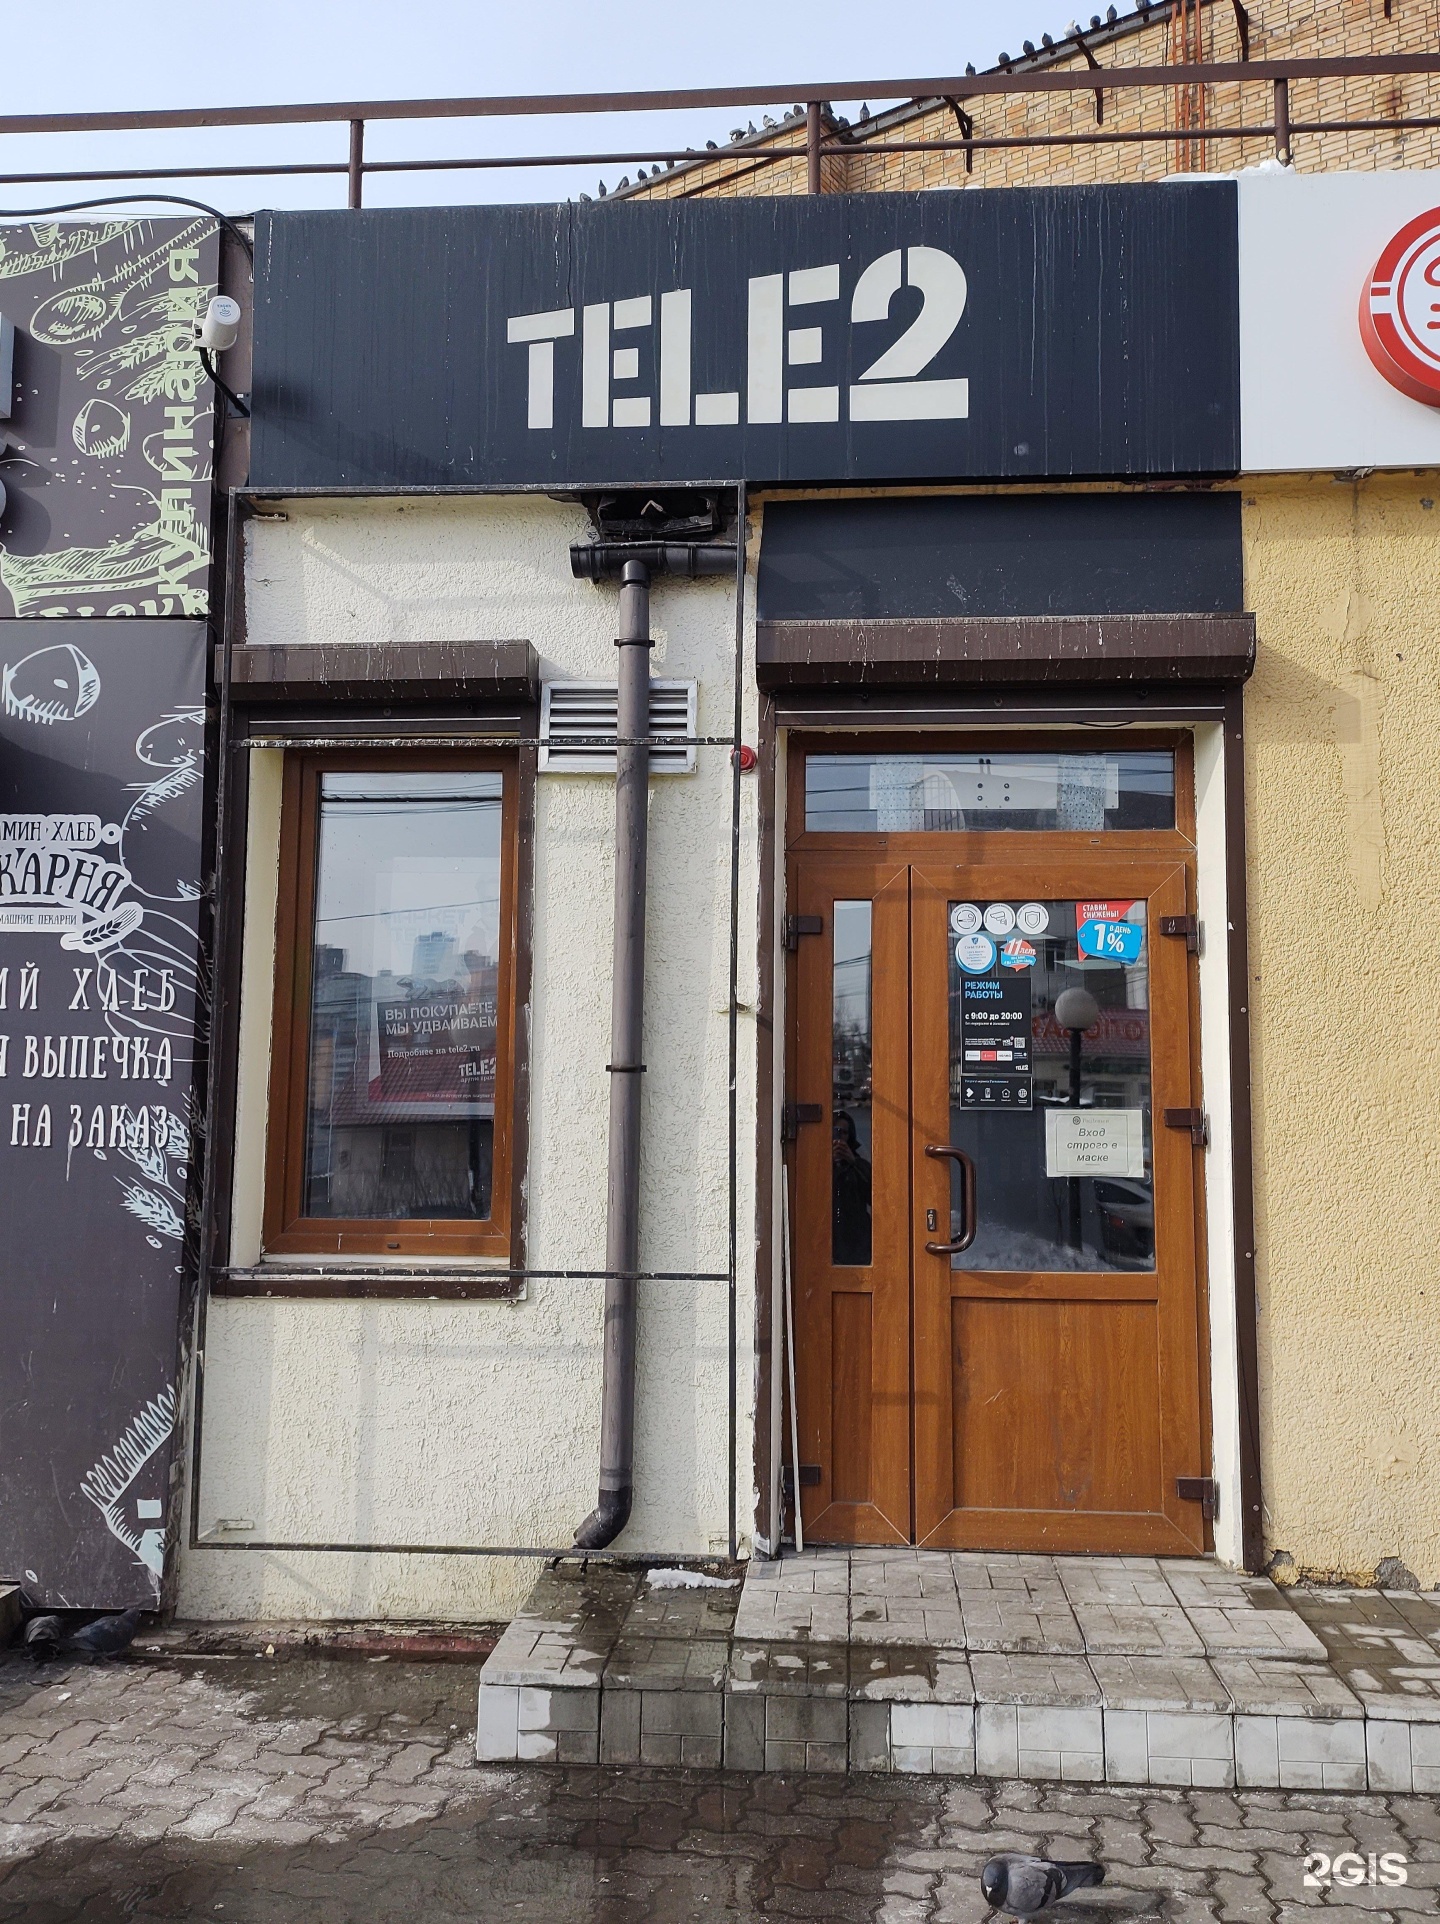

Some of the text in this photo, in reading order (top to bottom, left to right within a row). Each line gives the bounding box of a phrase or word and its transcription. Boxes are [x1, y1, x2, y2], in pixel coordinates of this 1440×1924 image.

[507, 246, 969, 429] TELE2
[157, 248, 201, 596] кулинария
[51, 821, 96, 841] ХЛЕБ
[1082, 903, 1108, 911] СТАВКИ
[38, 914, 77, 925] ПЕКАРНИ
[1082, 910, 1119, 919] СНИЖЕНЫ!
[1094, 923, 1125, 953] 1%
[68, 968, 176, 1013] ХЛЕБ
[964, 981, 1000, 990] РЕЖИМ
[964, 990, 1003, 999] РАБОТЫ
[385, 1008, 407, 1021] ВЫ
[1000, 1012, 1023, 1020] 20:00
[386, 1022, 409, 1035] МЫ
[22, 1035, 173, 1080] ВЫПЕЧКА
[387, 1048, 434, 1059] Подробнее
[448, 1045, 481, 1053] tele2.ru
[10, 1104, 169, 1149] НА ЗАКАЗ
[1078, 1127, 1106, 1137] Вход
[1066, 1142, 1108, 1151] строго
[1076, 1154, 1109, 1162] маске
